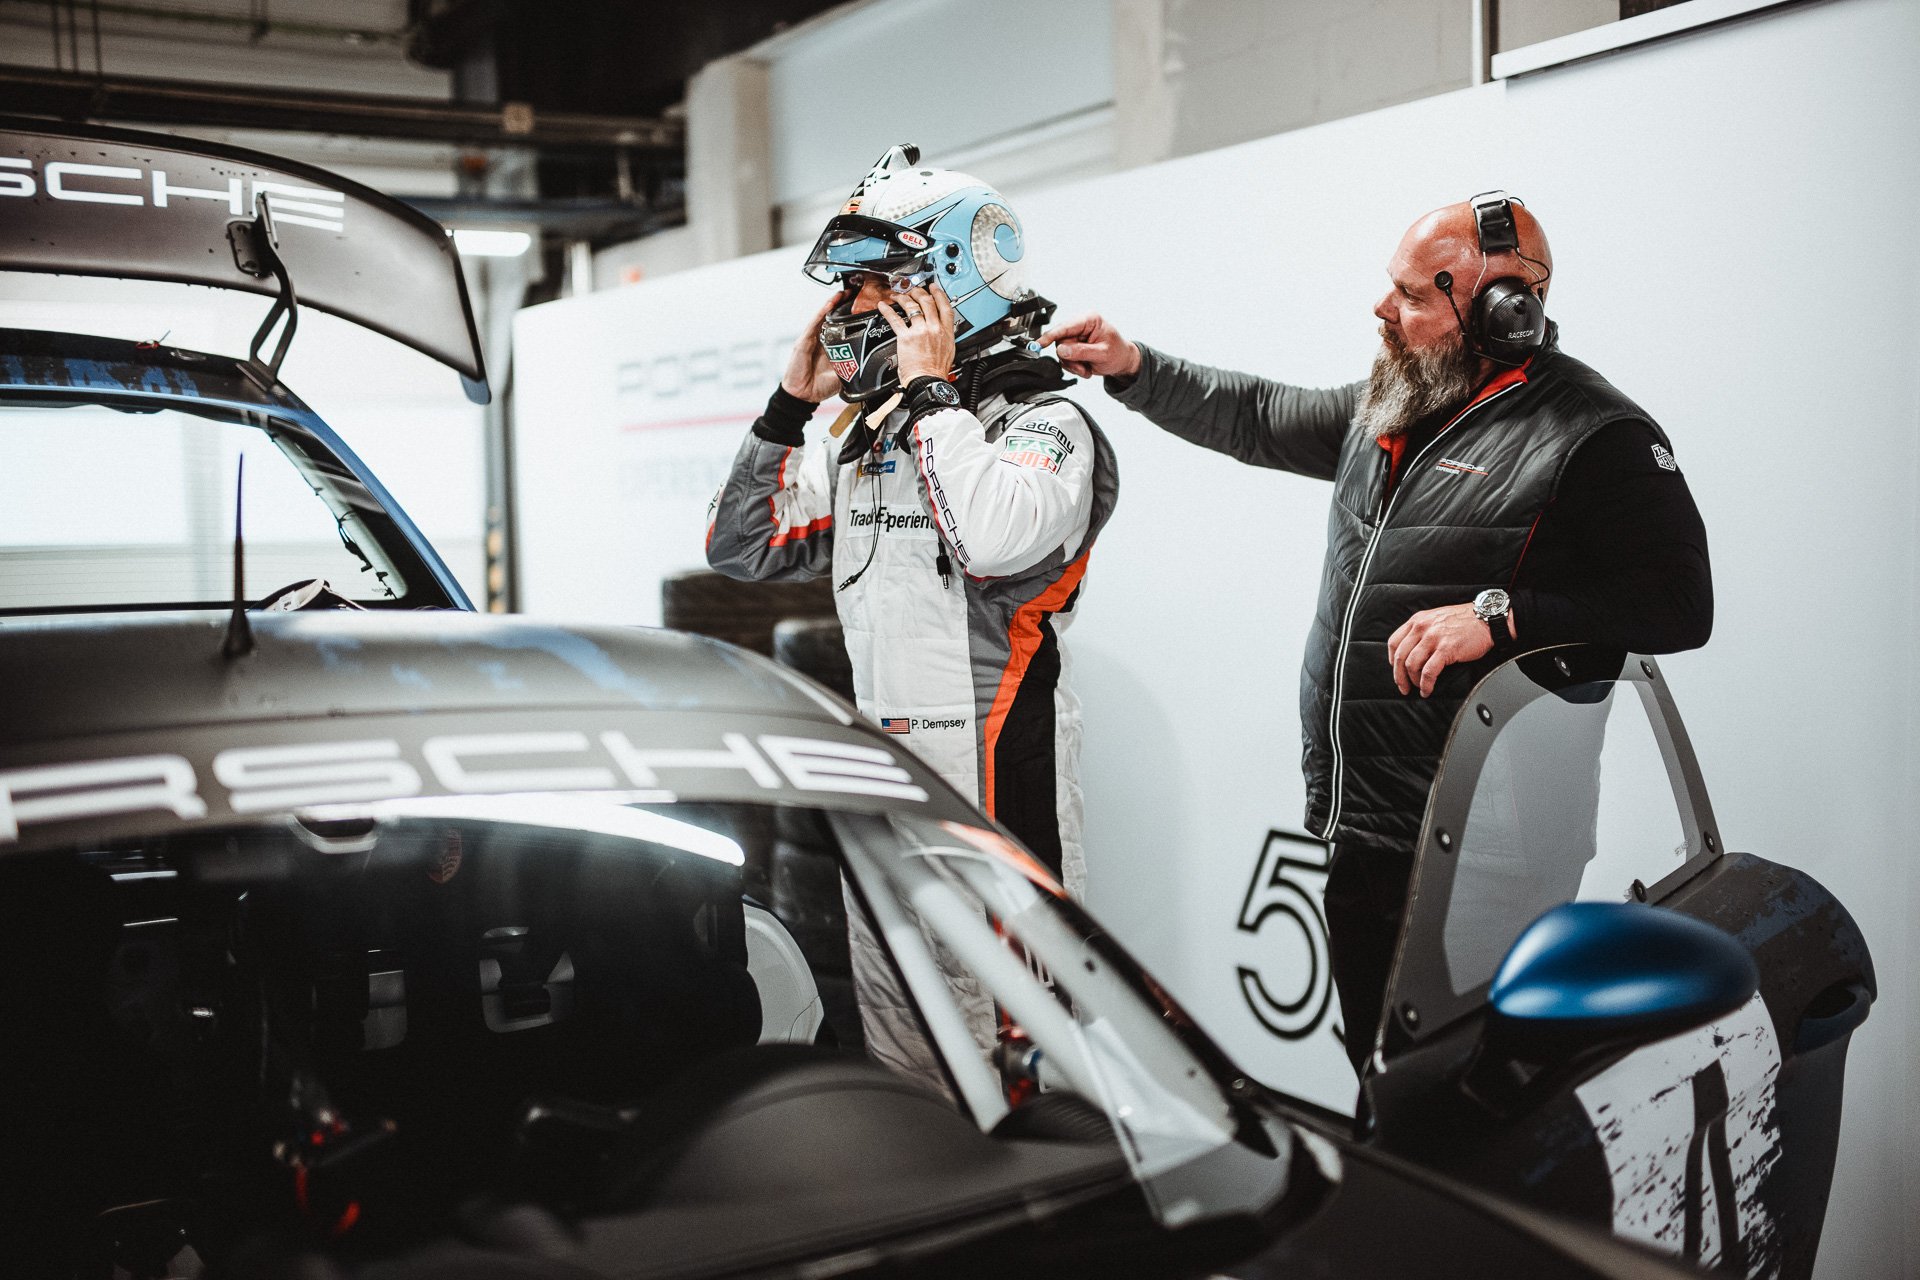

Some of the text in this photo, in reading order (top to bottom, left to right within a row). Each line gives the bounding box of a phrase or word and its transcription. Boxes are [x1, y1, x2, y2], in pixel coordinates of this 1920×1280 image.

[903, 233, 923, 246] BELL
[1507, 329, 1535, 339] RACECOM
[827, 346, 851, 360] TAG
[617, 335, 797, 399] PORS
[1020, 421, 1076, 455] ademy
[1009, 440, 1061, 463] TAG
[1653, 446, 1668, 456] TA
[925, 438, 971, 565] PORSCHE
[911, 719, 966, 730] P. Dempsey
[0, 731, 929, 843] RSCHE
